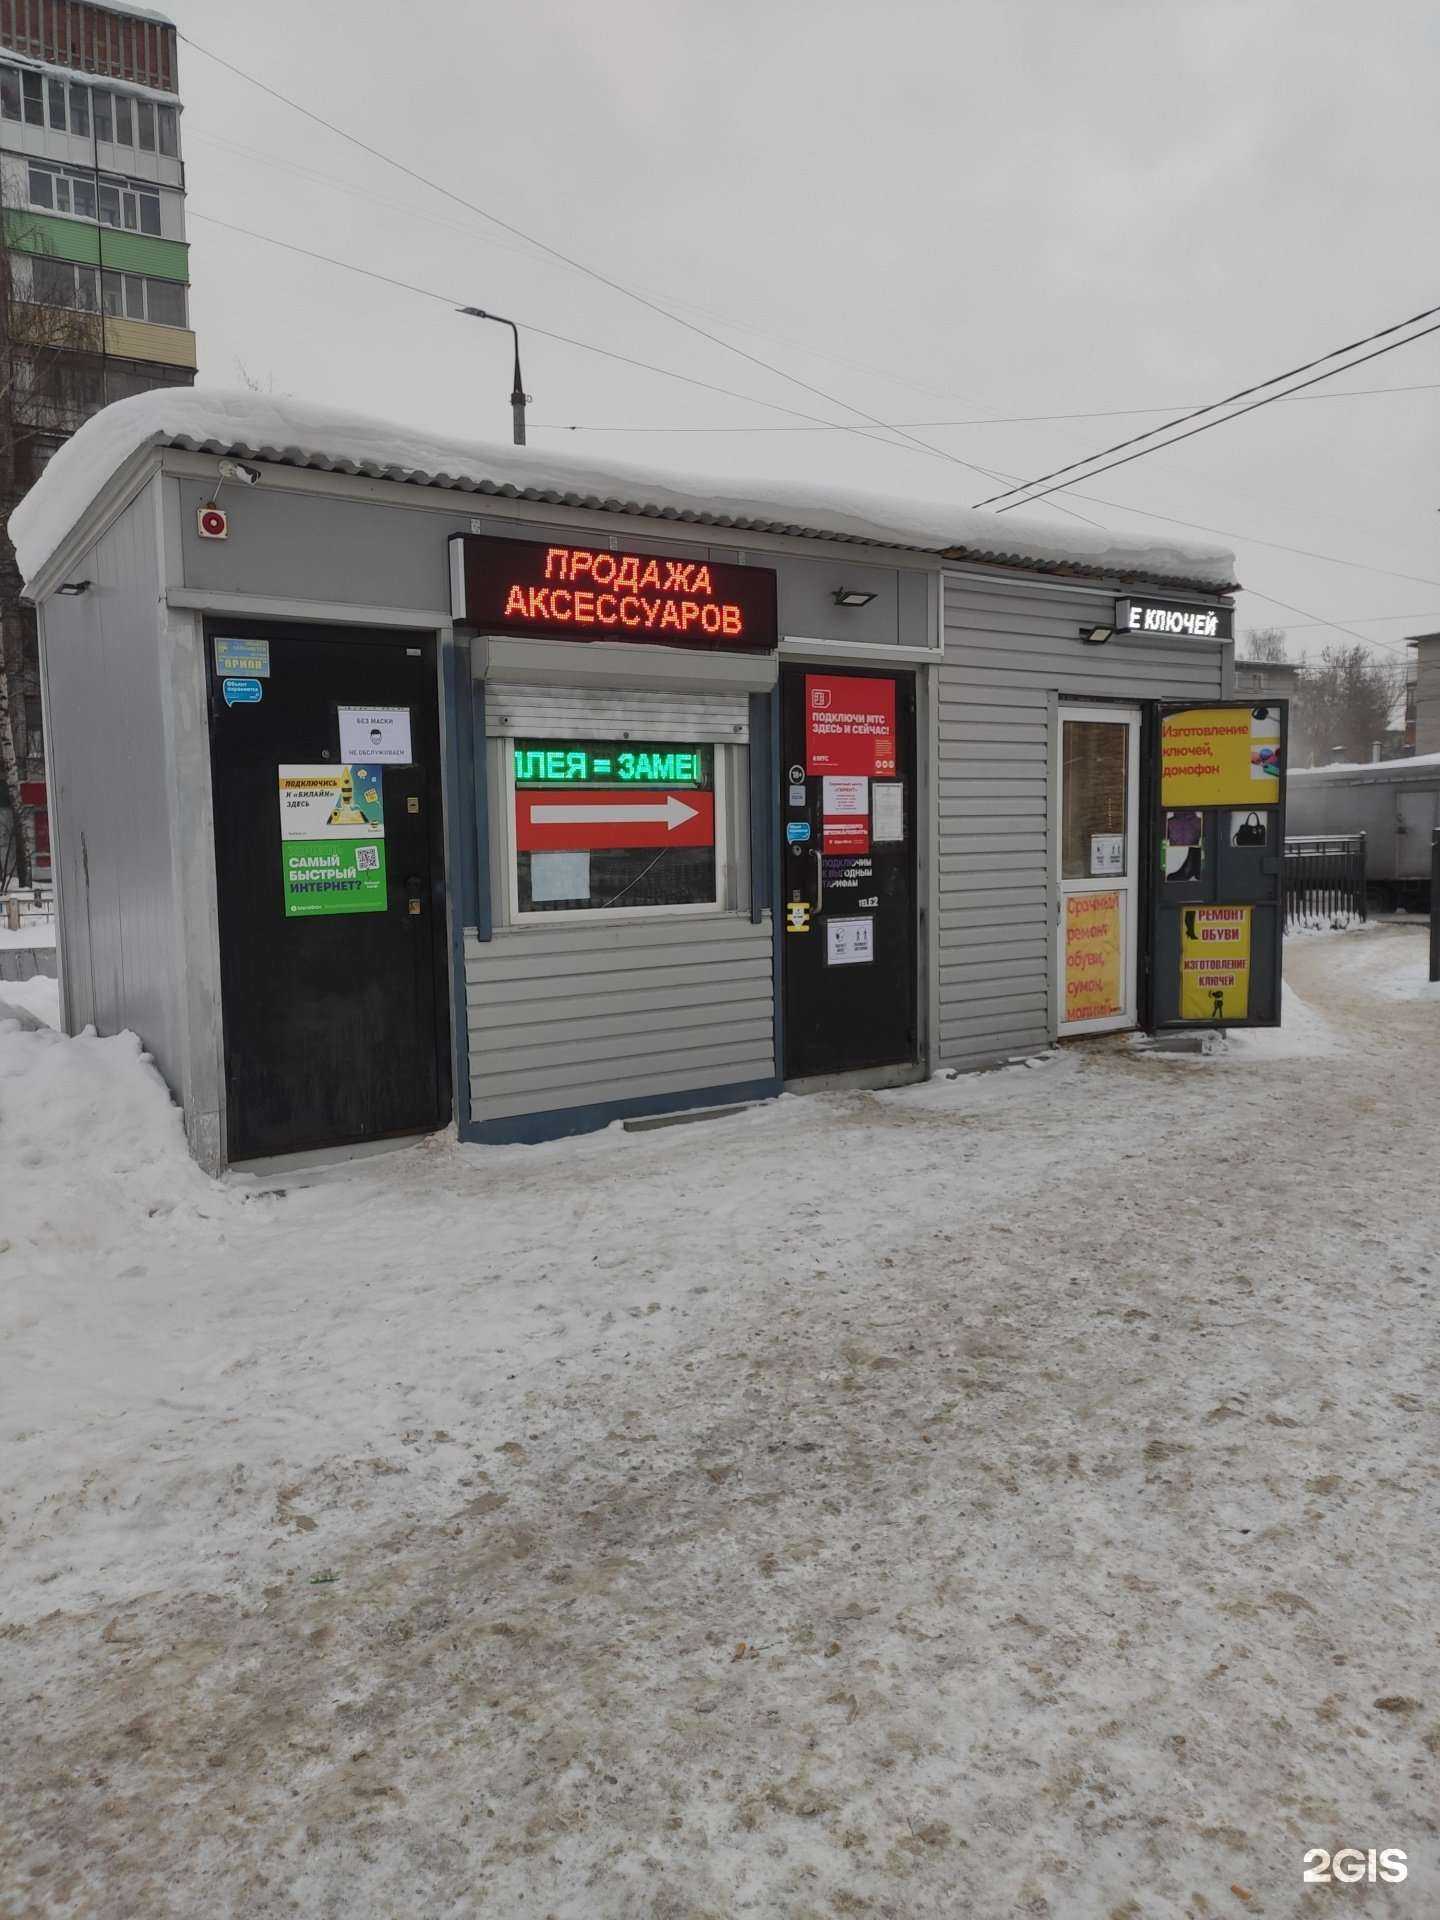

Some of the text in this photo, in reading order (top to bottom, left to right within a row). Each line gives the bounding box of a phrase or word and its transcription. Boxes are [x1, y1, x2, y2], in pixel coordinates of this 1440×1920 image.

[545, 548, 711, 594] ПРОДАЖА
[504, 584, 743, 634] АКСЕССУАРОВ
[1128, 607, 1219, 636] Е КЛЮЧЕЙ
[812, 723, 890, 736] ЗДЕСЬ И СЕЙЧАС!
[1162, 724, 1249, 738] Изготовление
[1162, 741, 1214, 757] ключей,
[617, 753, 698, 779] ЗАМЕ
[1163, 763, 1221, 778] домофон
[284, 779, 338, 789] ПОДКЛЮЧИСЬ
[286, 800, 310, 808] ЗДЕСЬ
[289, 854, 340, 868] САМЫЙ
[289, 866, 357, 881] БЫСТРЫЙ
[290, 880, 362, 893] ИНТЕРНЕТ?
[1199, 909, 1244, 921] РЕМОНТ
[1067, 924, 1109, 945] ремонт
[1201, 929, 1239, 941] ОБУВИ
[1184, 960, 1248, 970] ИЗГОТОВЛЕНИЕ
